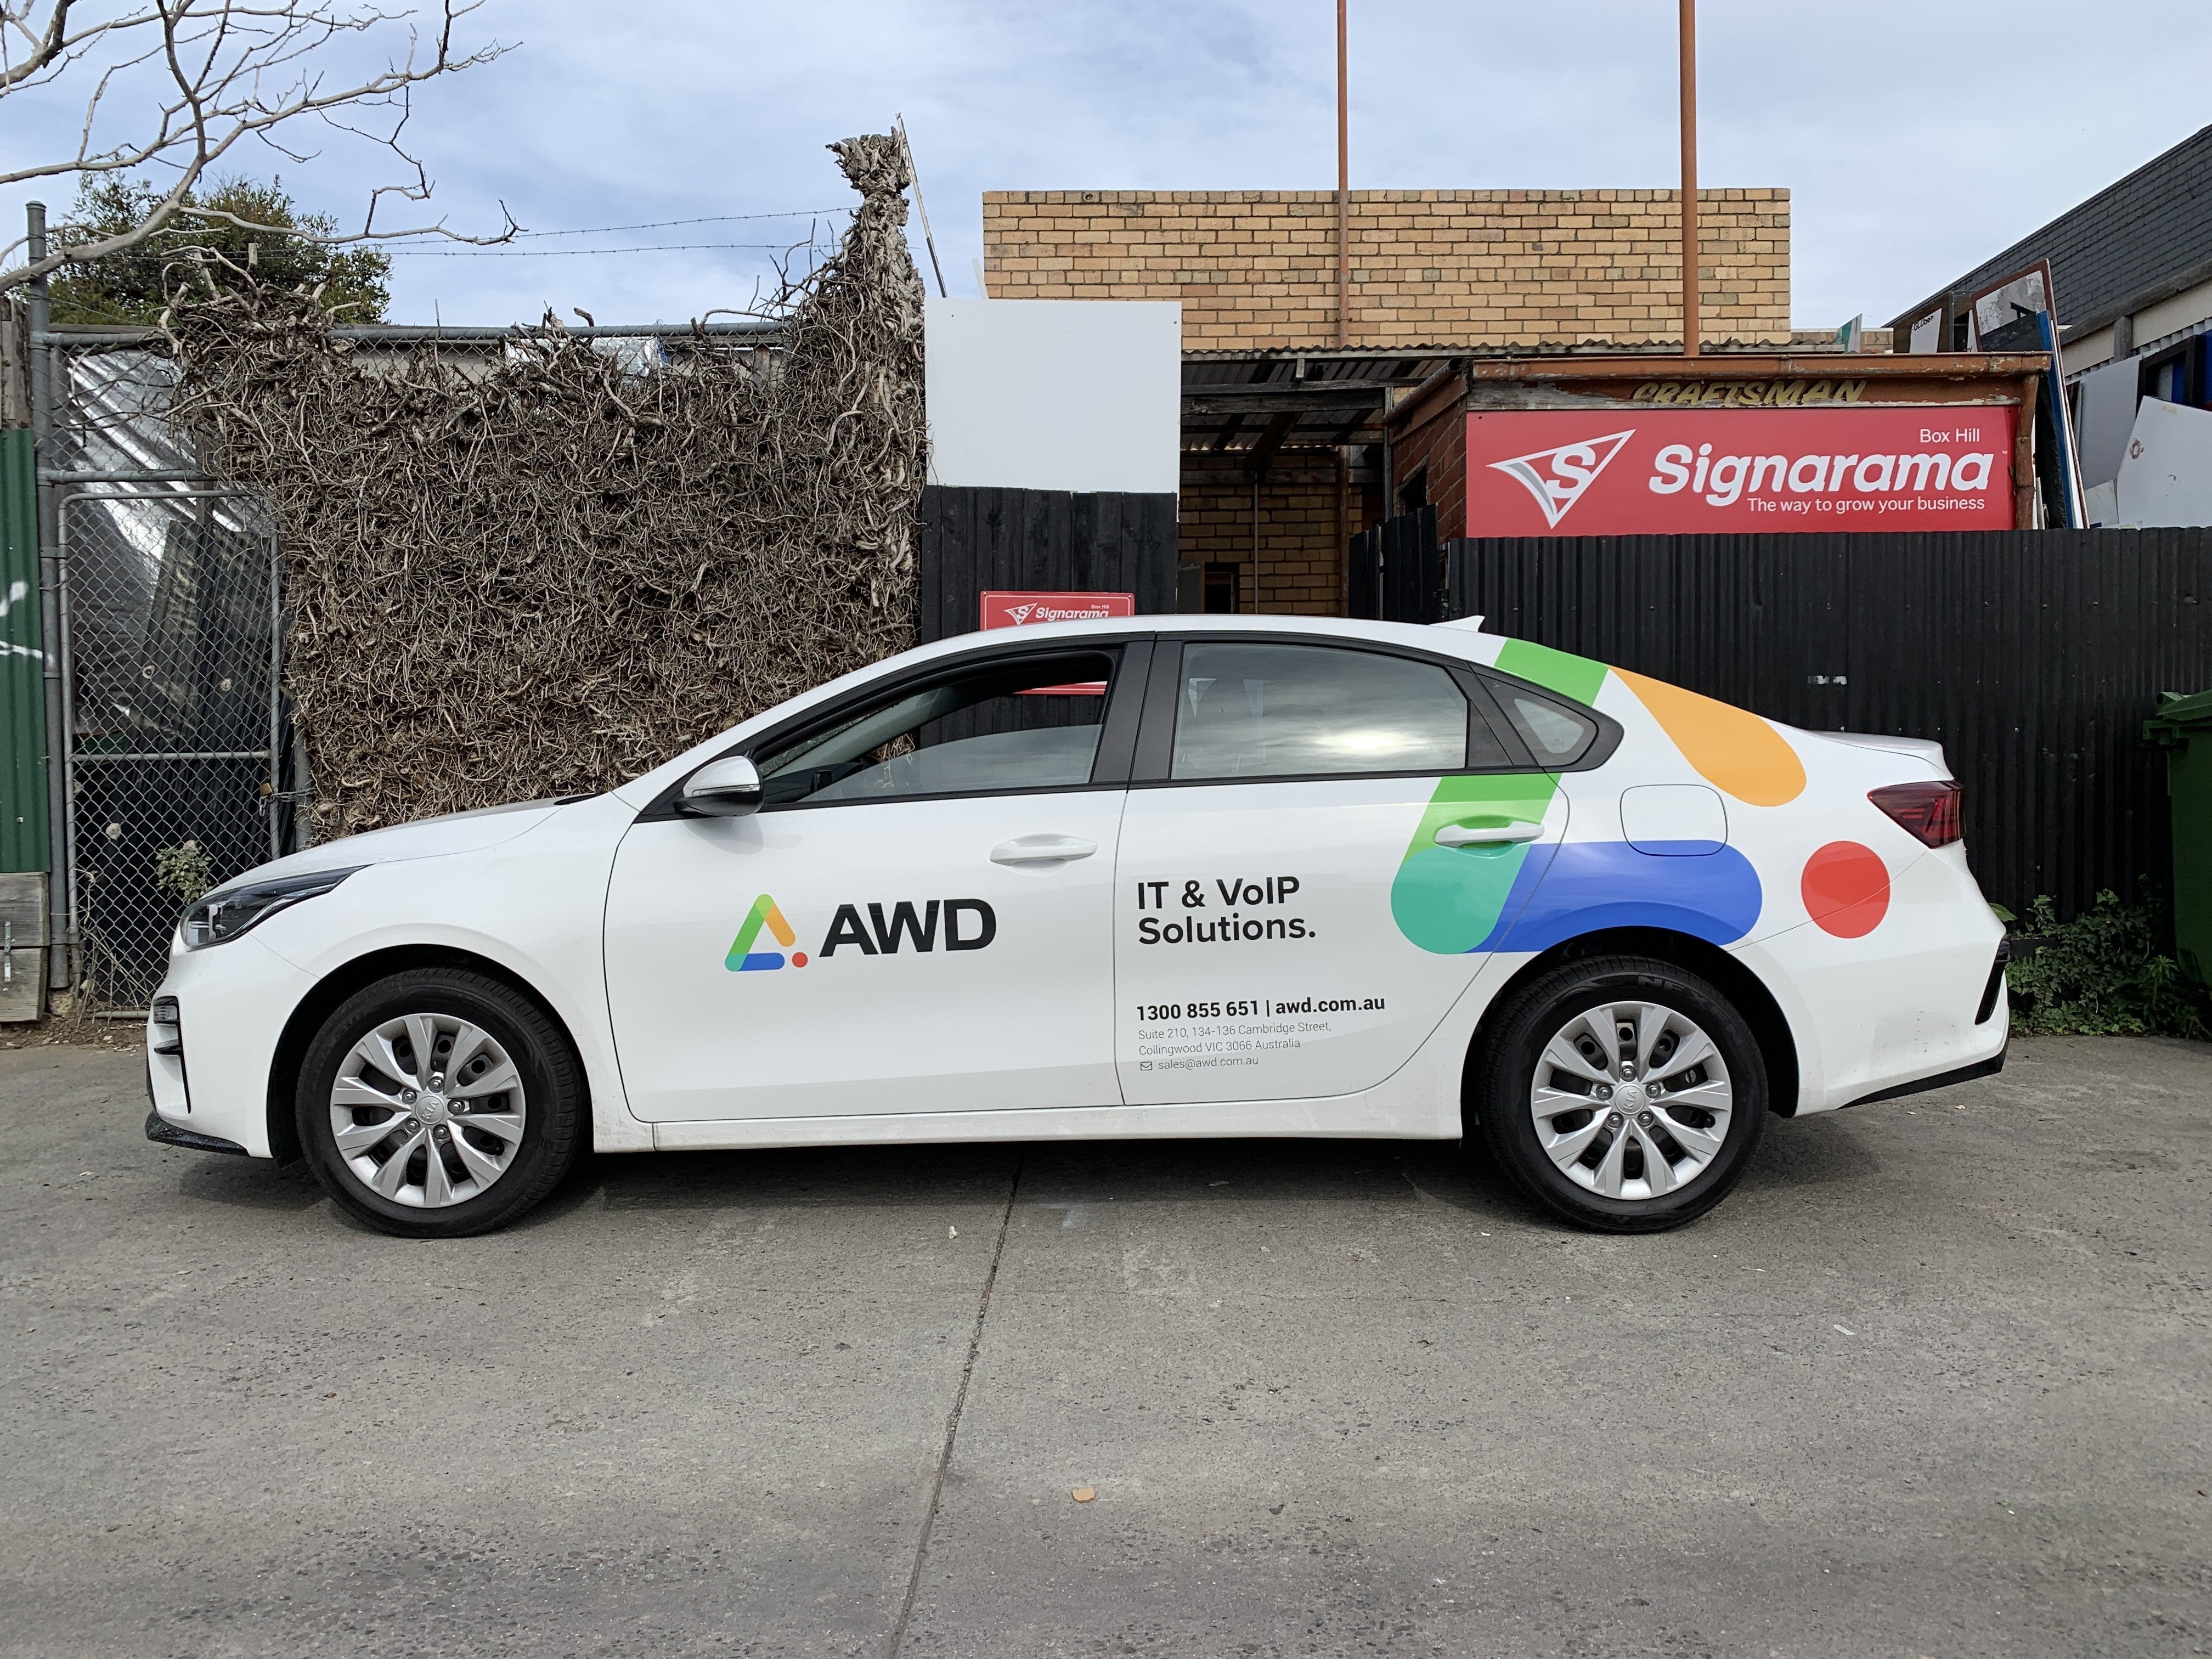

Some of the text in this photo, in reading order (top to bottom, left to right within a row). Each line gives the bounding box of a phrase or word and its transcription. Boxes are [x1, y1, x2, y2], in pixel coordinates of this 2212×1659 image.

[1632, 379, 1866, 405] CRAFTSMAN
[1920, 428, 1980, 443] Box Hill
[1649, 443, 1994, 506] Signarama
[1747, 496, 1985, 515] The way to grow your business
[1035, 607, 1109, 622] Signarama
[1138, 876, 1300, 910] IT & VoIP
[819, 898, 997, 957] AWD
[1138, 912, 1316, 945] Solutions.
[1137, 1005, 1181, 1021] 1300
[1187, 1002, 1221, 1018] 855
[1226, 1000, 1259, 1017] 651
[1276, 996, 1385, 1014] awd.com.au
[1138, 1021, 1331, 1040] Suite 210, 134-136 Cambridge Street,
[1139, 1038, 1300, 1056] Collingwood VIC 3066 Australia
[1158, 1057, 1259, 1070] sales@awd.com.au
